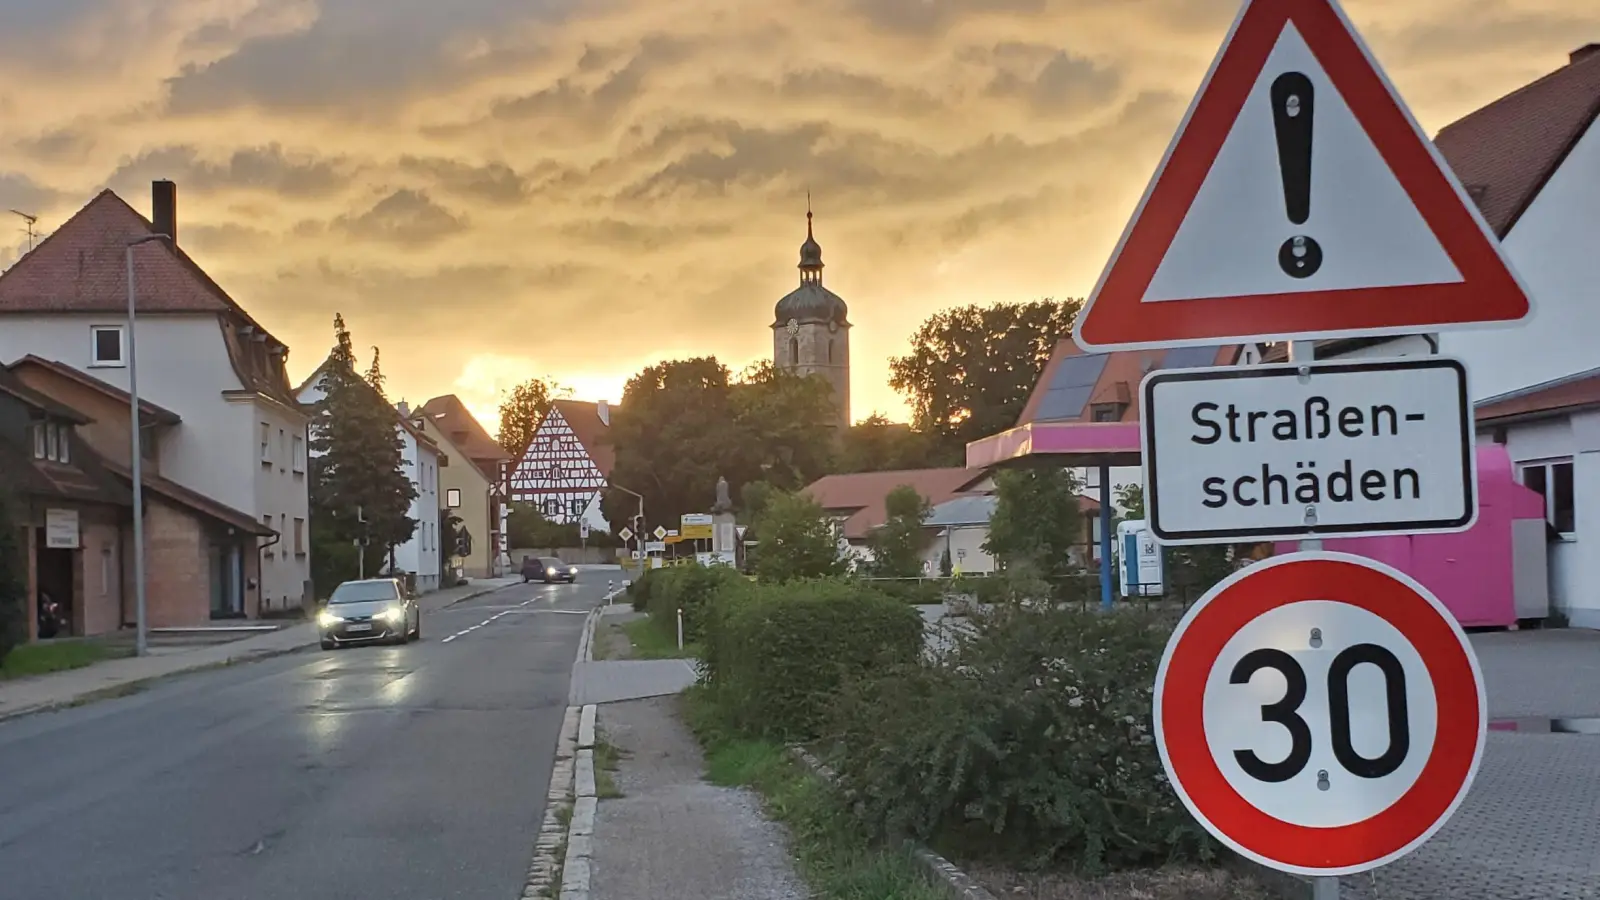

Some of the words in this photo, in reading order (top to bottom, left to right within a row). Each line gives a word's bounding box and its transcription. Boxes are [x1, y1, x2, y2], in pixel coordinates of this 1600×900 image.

[1190, 396, 1425, 445] Straßen-
[1202, 460, 1420, 508] schäden
[1229, 643, 1411, 783] 30
